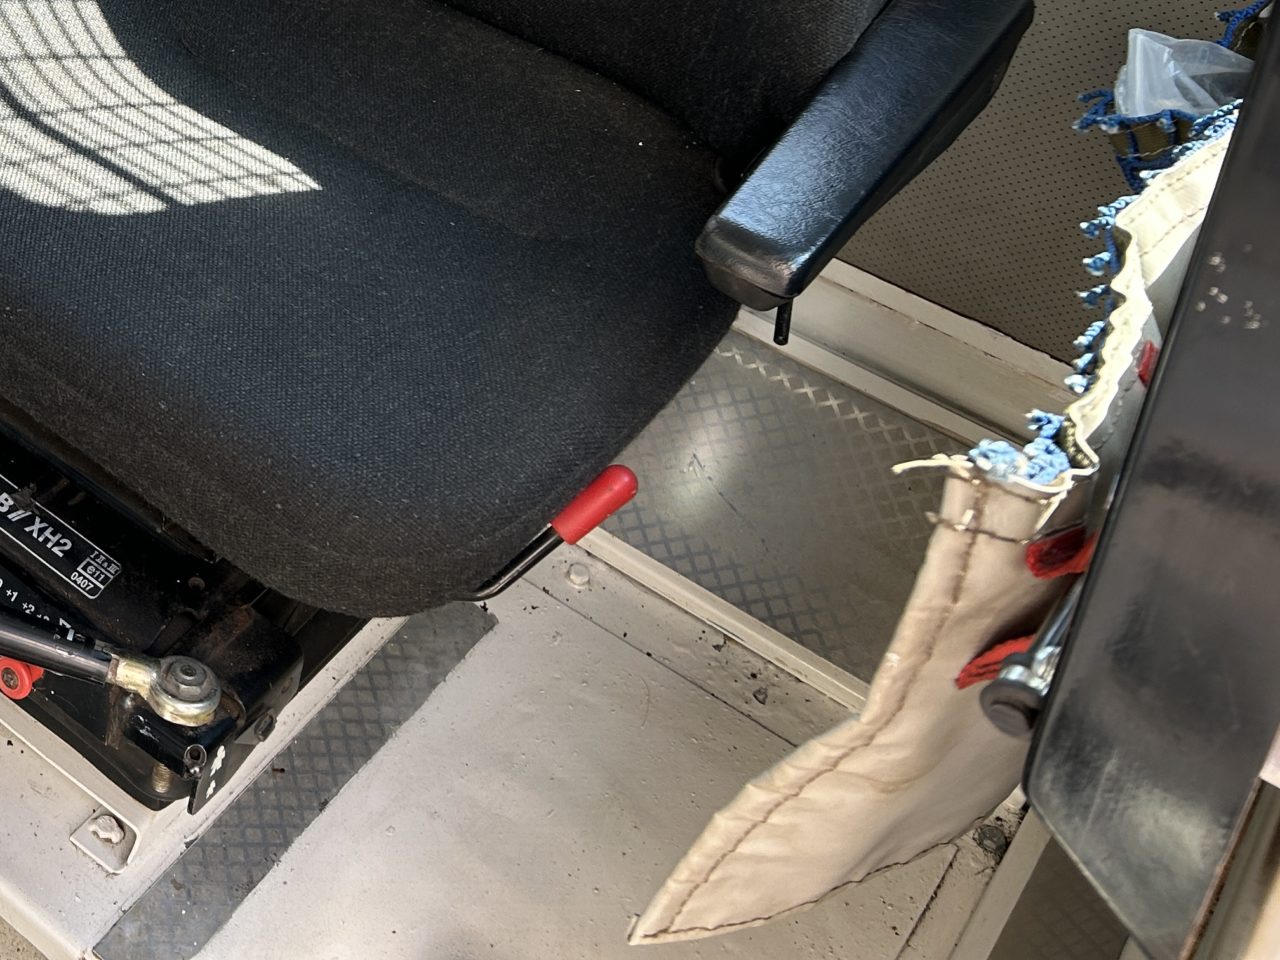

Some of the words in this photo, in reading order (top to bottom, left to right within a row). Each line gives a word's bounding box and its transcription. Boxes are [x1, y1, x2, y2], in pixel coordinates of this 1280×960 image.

[23, 515, 73, 558] XH2
[70, 571, 95, 591] 0407
[86, 565, 106, 582] e11
